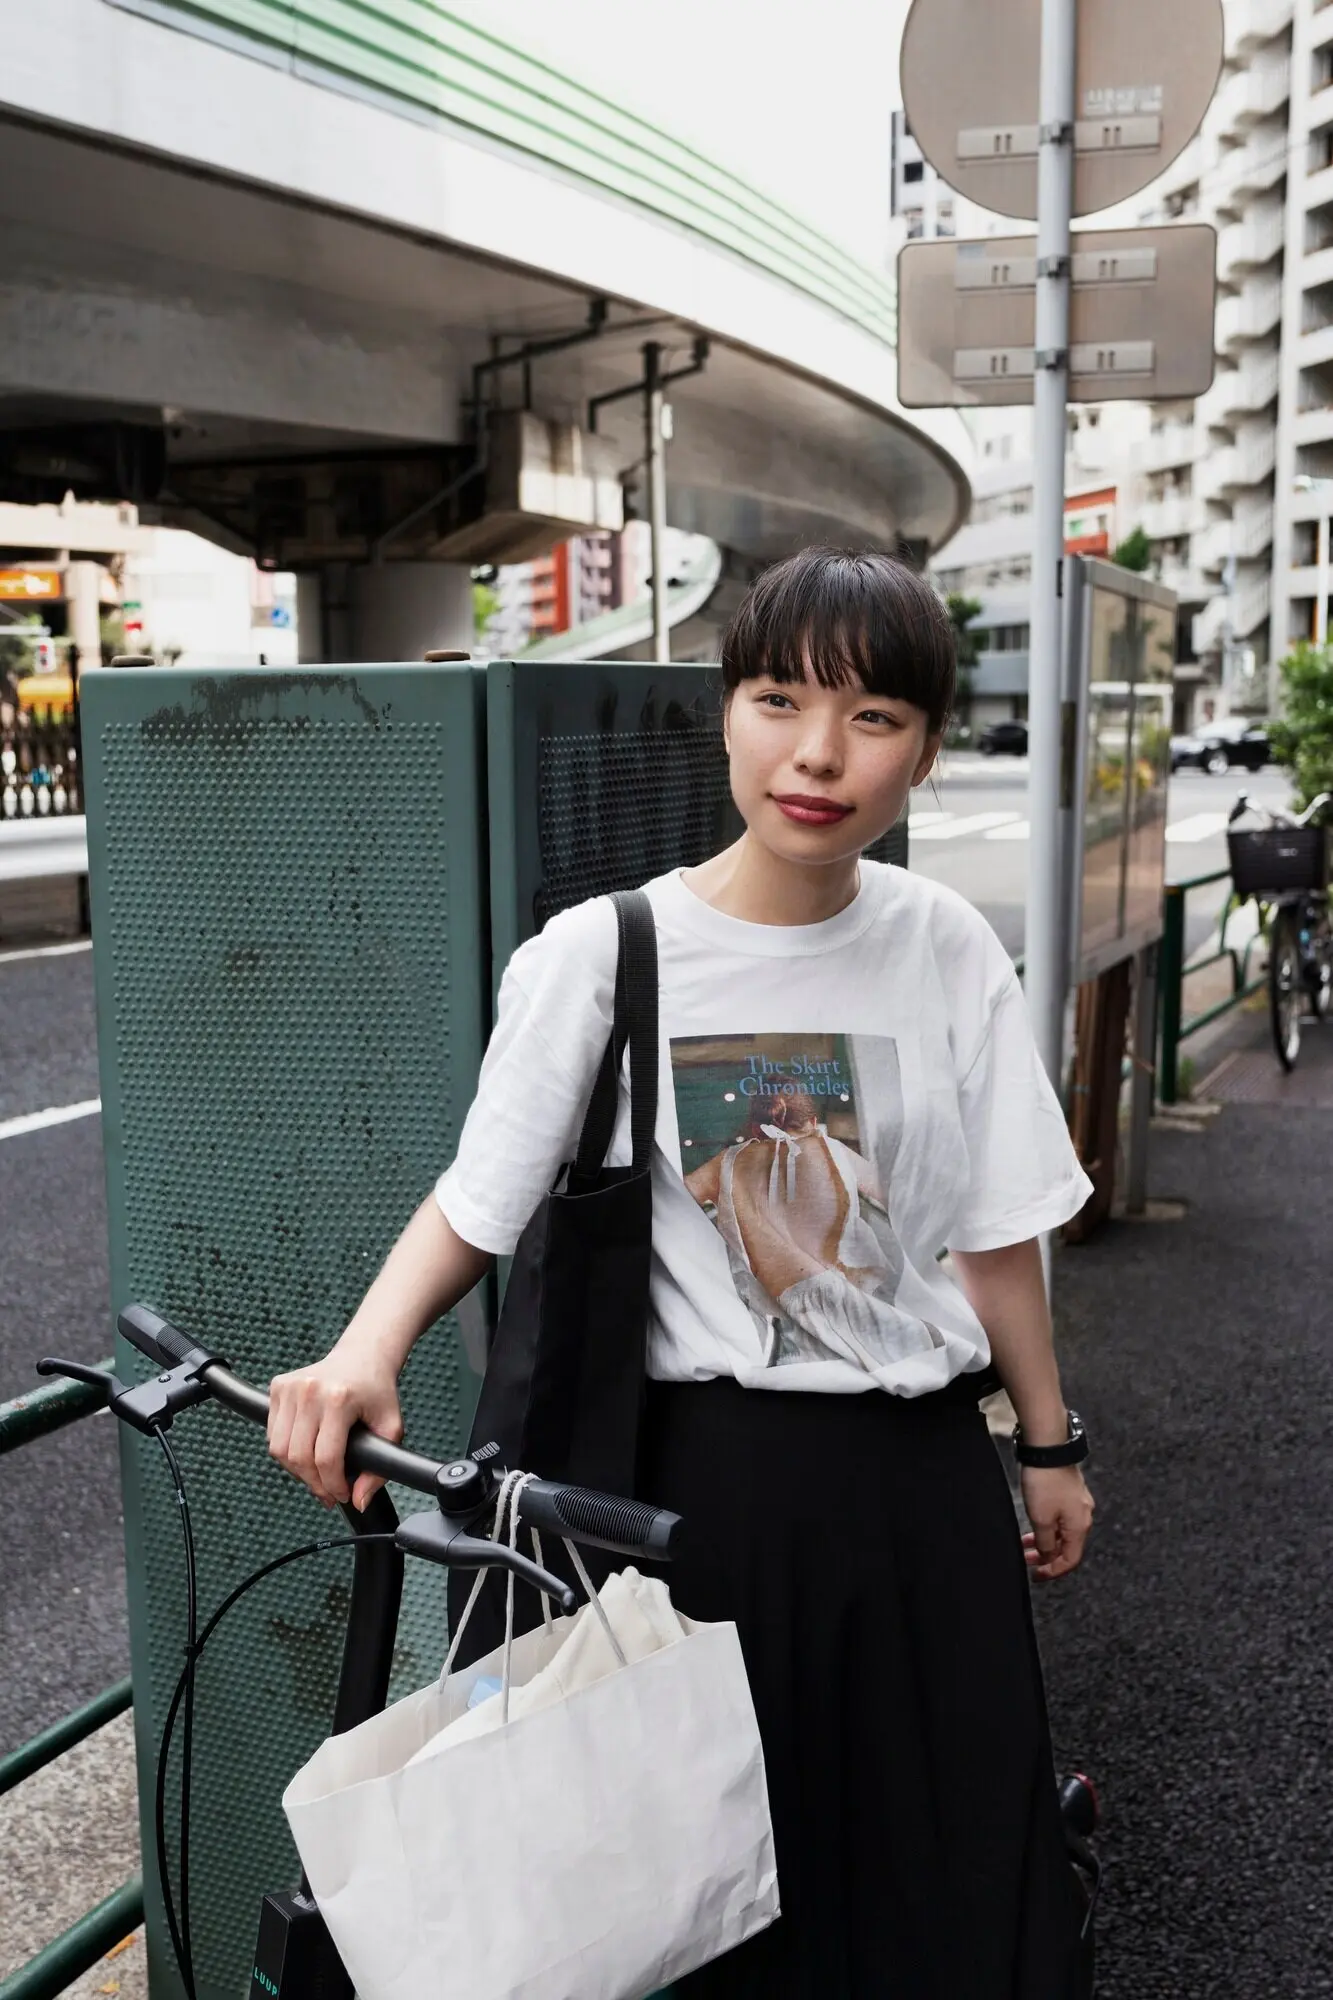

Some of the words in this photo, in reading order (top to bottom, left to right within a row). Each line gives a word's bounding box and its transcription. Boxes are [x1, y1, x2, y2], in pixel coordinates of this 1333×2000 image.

[745, 1055, 785, 1075] The
[791, 1054, 841, 1075] Skirt
[739, 1075, 849, 1096] Chronicles
[254, 1966, 278, 1996] LUUP
